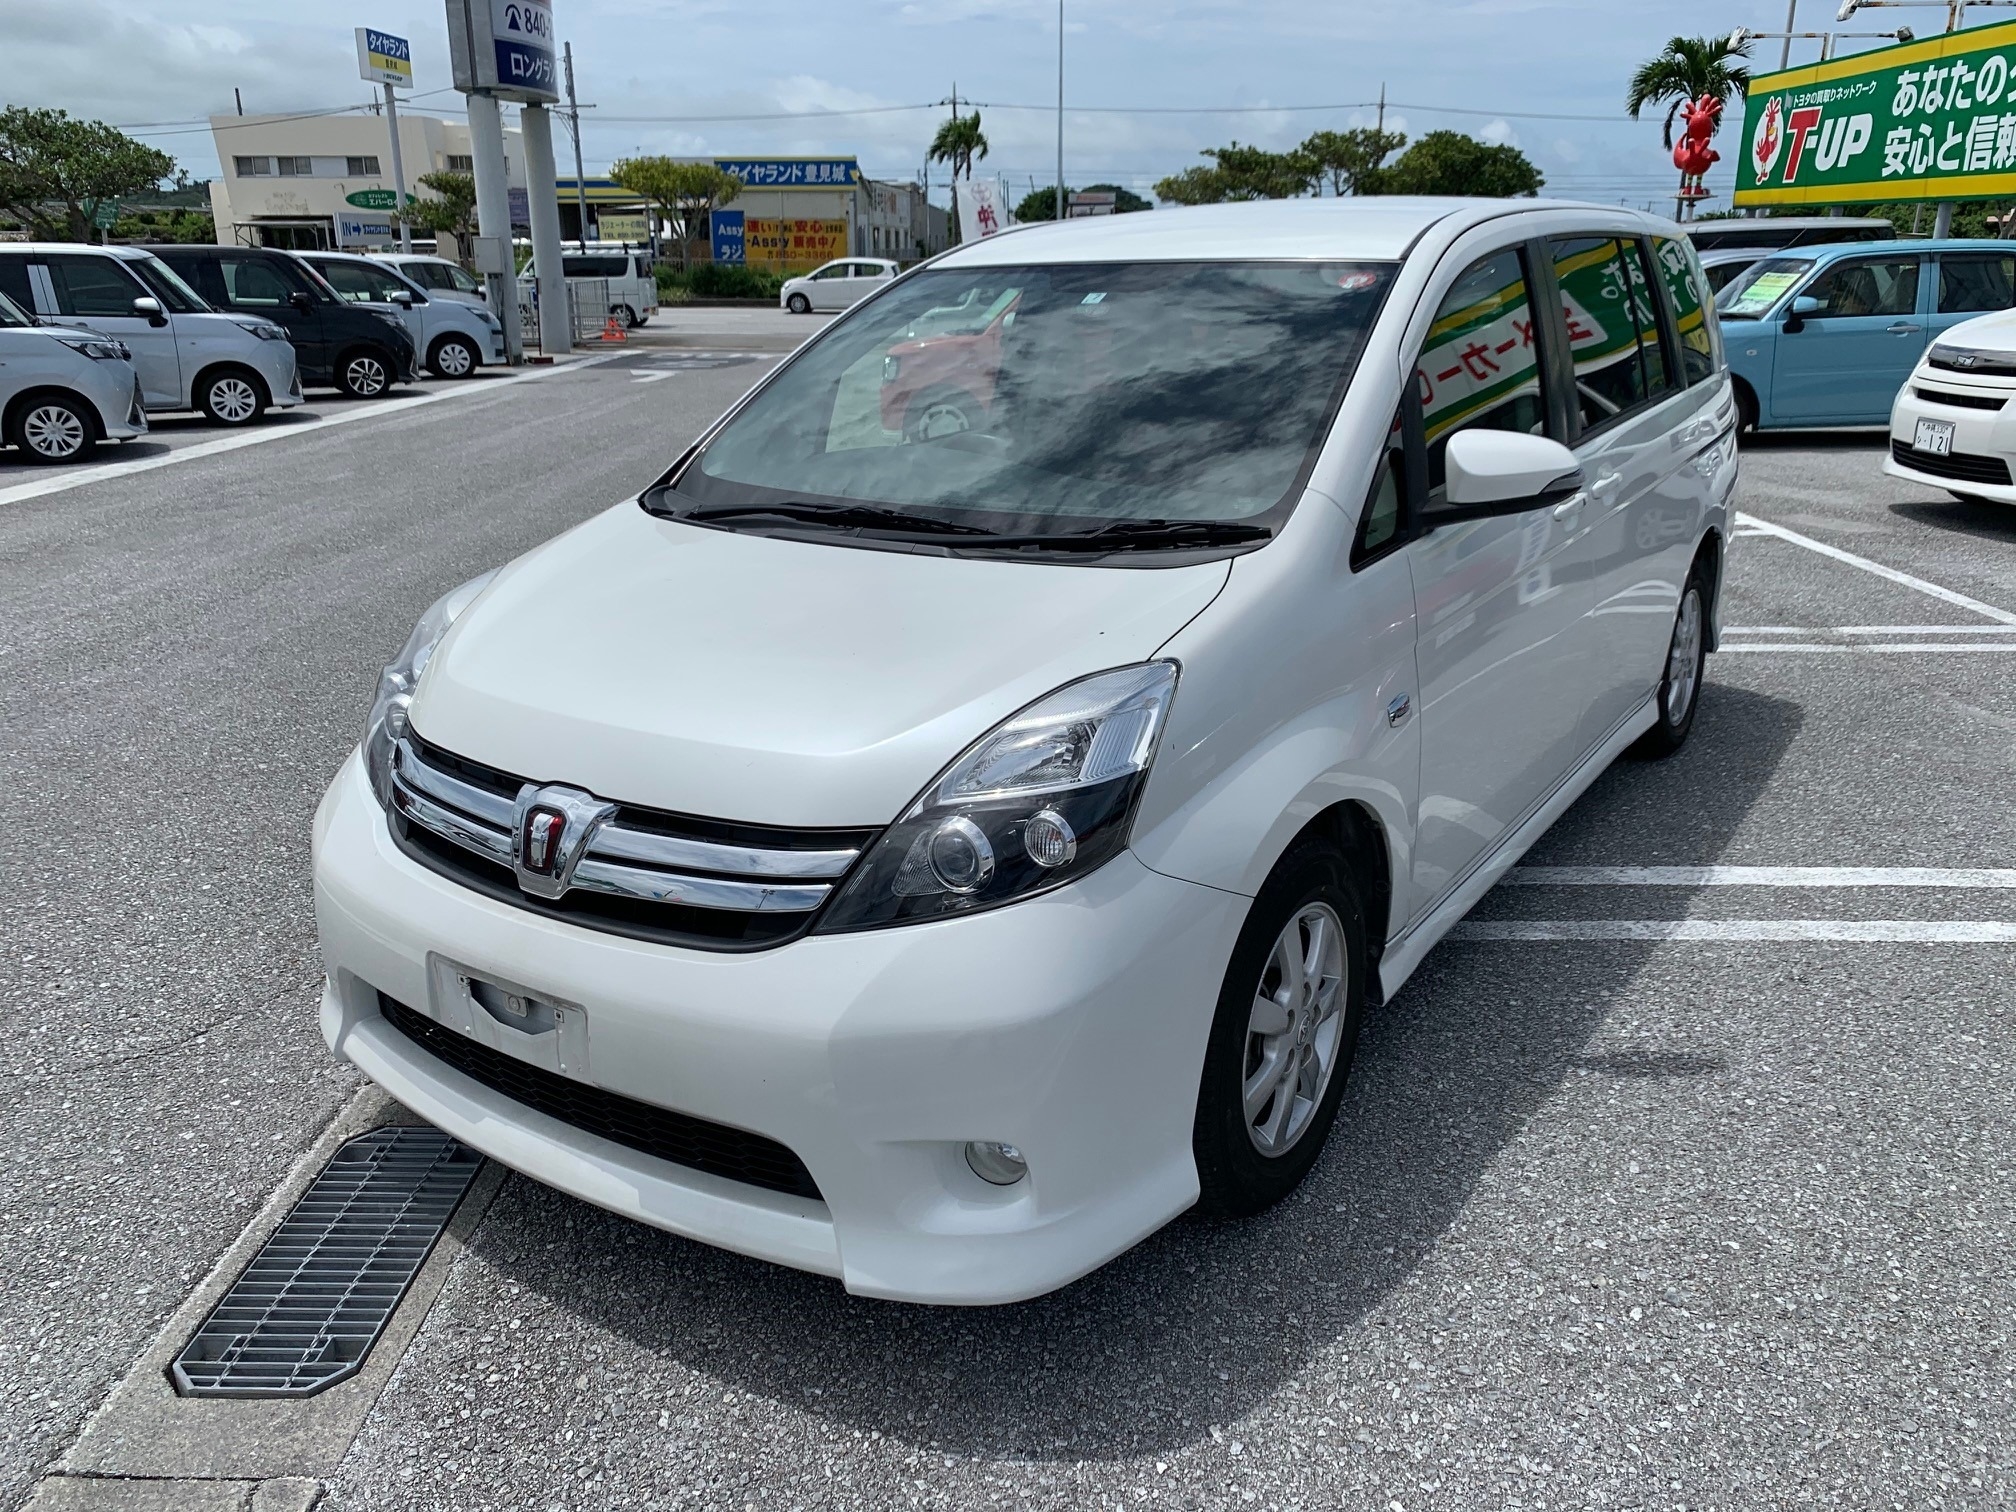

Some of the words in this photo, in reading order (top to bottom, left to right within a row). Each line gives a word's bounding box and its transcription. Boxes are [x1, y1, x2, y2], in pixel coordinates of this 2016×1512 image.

[369, 32, 408, 58] タイヤランド
[1793, 80, 1878, 108] トヨタの買取りネットワーク
[1782, 105, 1874, 184] T-UP
[342, 221, 352, 237] IN
